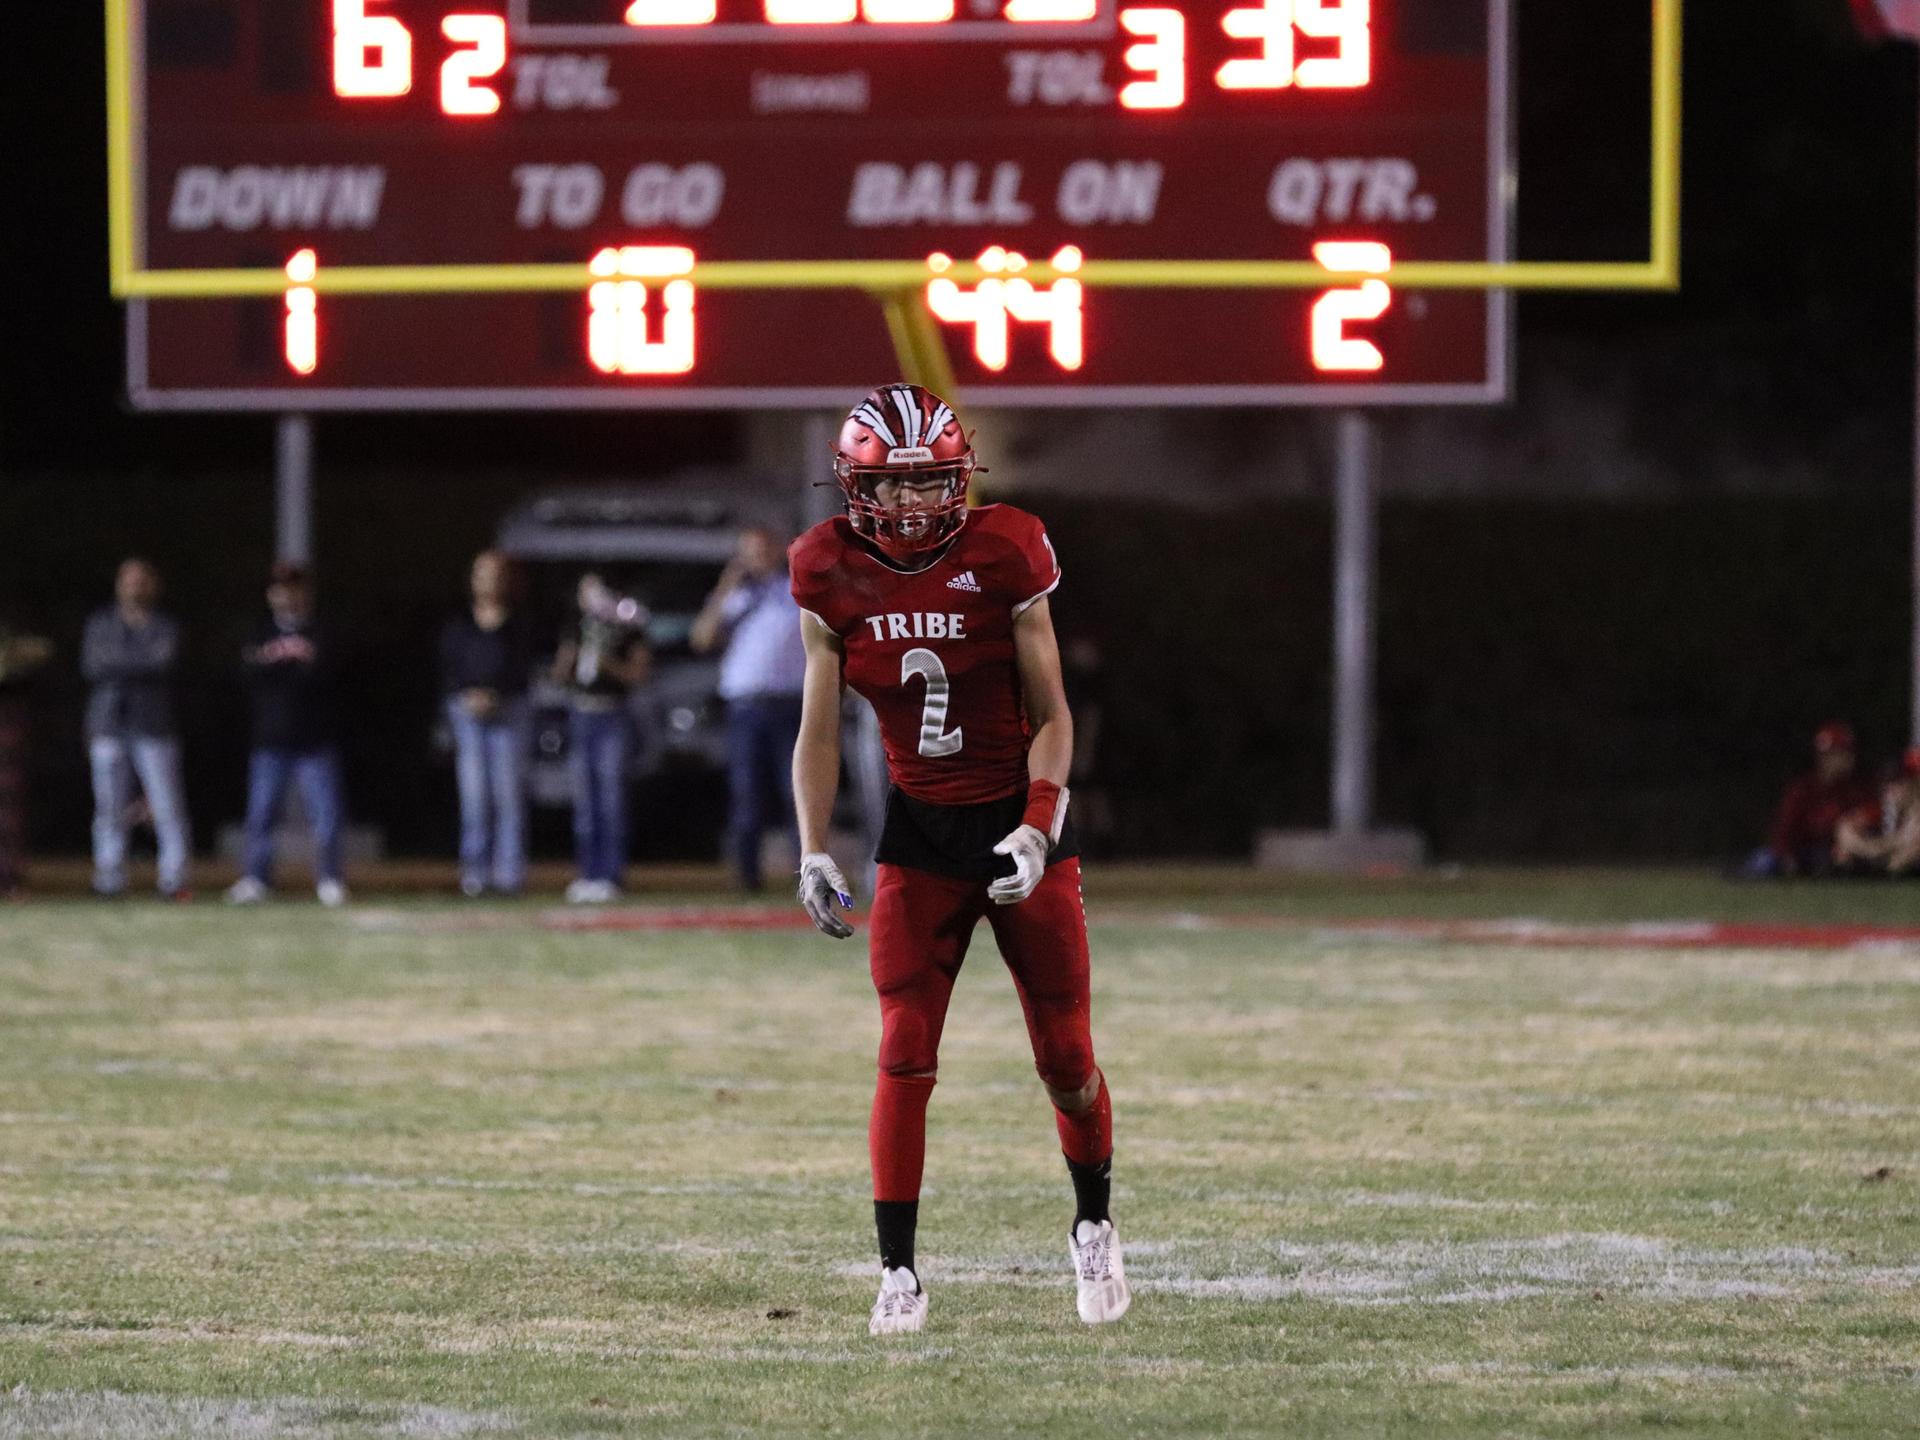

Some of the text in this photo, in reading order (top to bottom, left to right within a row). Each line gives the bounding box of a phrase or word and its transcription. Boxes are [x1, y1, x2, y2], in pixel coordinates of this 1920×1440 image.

[440, 14, 506, 116] 2
[1119, 8, 1185, 109] 3
[170, 166, 386, 231] DOWN
[512, 162, 725, 229] TO GO
[847, 160, 1162, 226] BALL ON
[1267, 157, 1436, 226] QTR.
[285, 248, 317, 374] 1
[588, 246, 695, 374] 10
[926, 245, 1083, 370] 44
[1311, 241, 1391, 370] 2
[865, 612, 967, 642] TRIBE
[946, 581, 982, 593] adidas
[901, 647, 963, 758] 2
